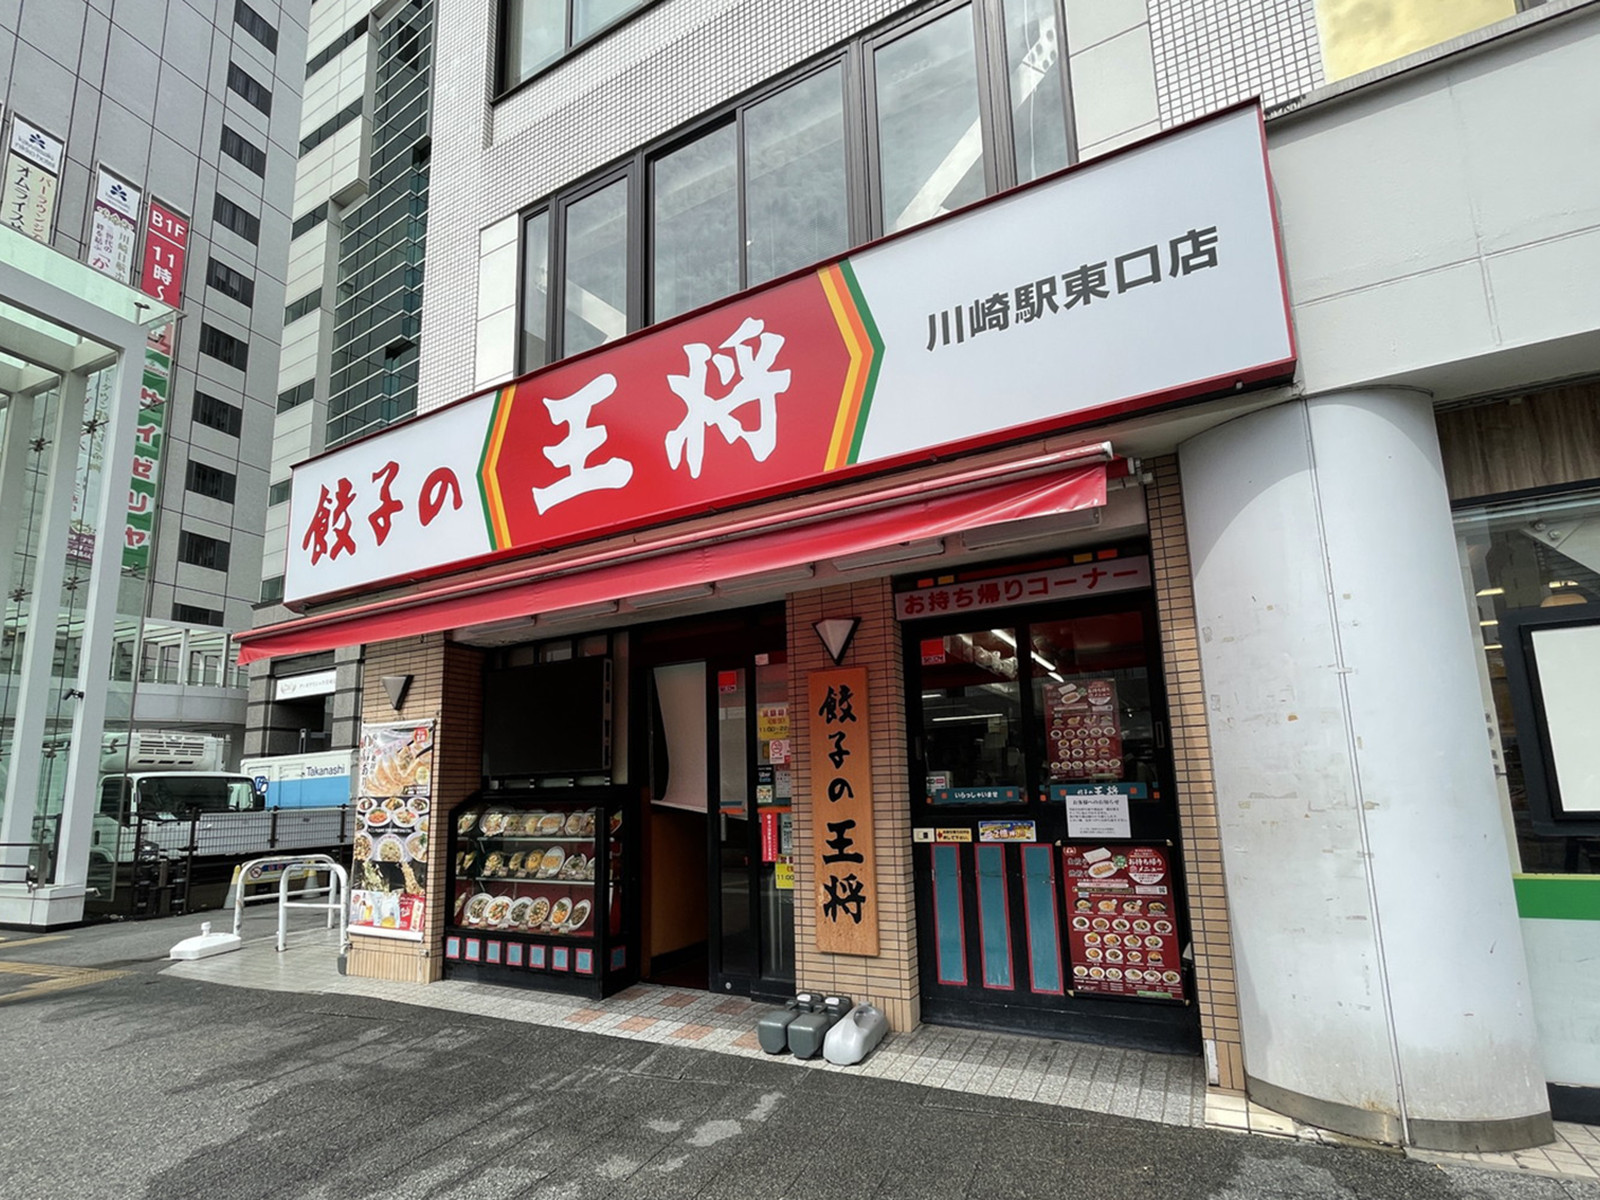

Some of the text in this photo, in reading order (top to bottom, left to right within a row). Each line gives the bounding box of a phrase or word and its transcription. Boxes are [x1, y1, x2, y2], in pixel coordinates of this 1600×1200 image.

[152, 210, 185, 238] B1F
[926, 226, 1219, 352] 川崎駅東口店
[302, 317, 792, 567] 餃子の 王将
[904, 567, 1139, 615] お持ち帰りコーナー
[306, 763, 346, 776] Takanashi
[818, 685, 867, 924] 餃子の王将
[954, 791, 999, 799] いらっしゃいませ
